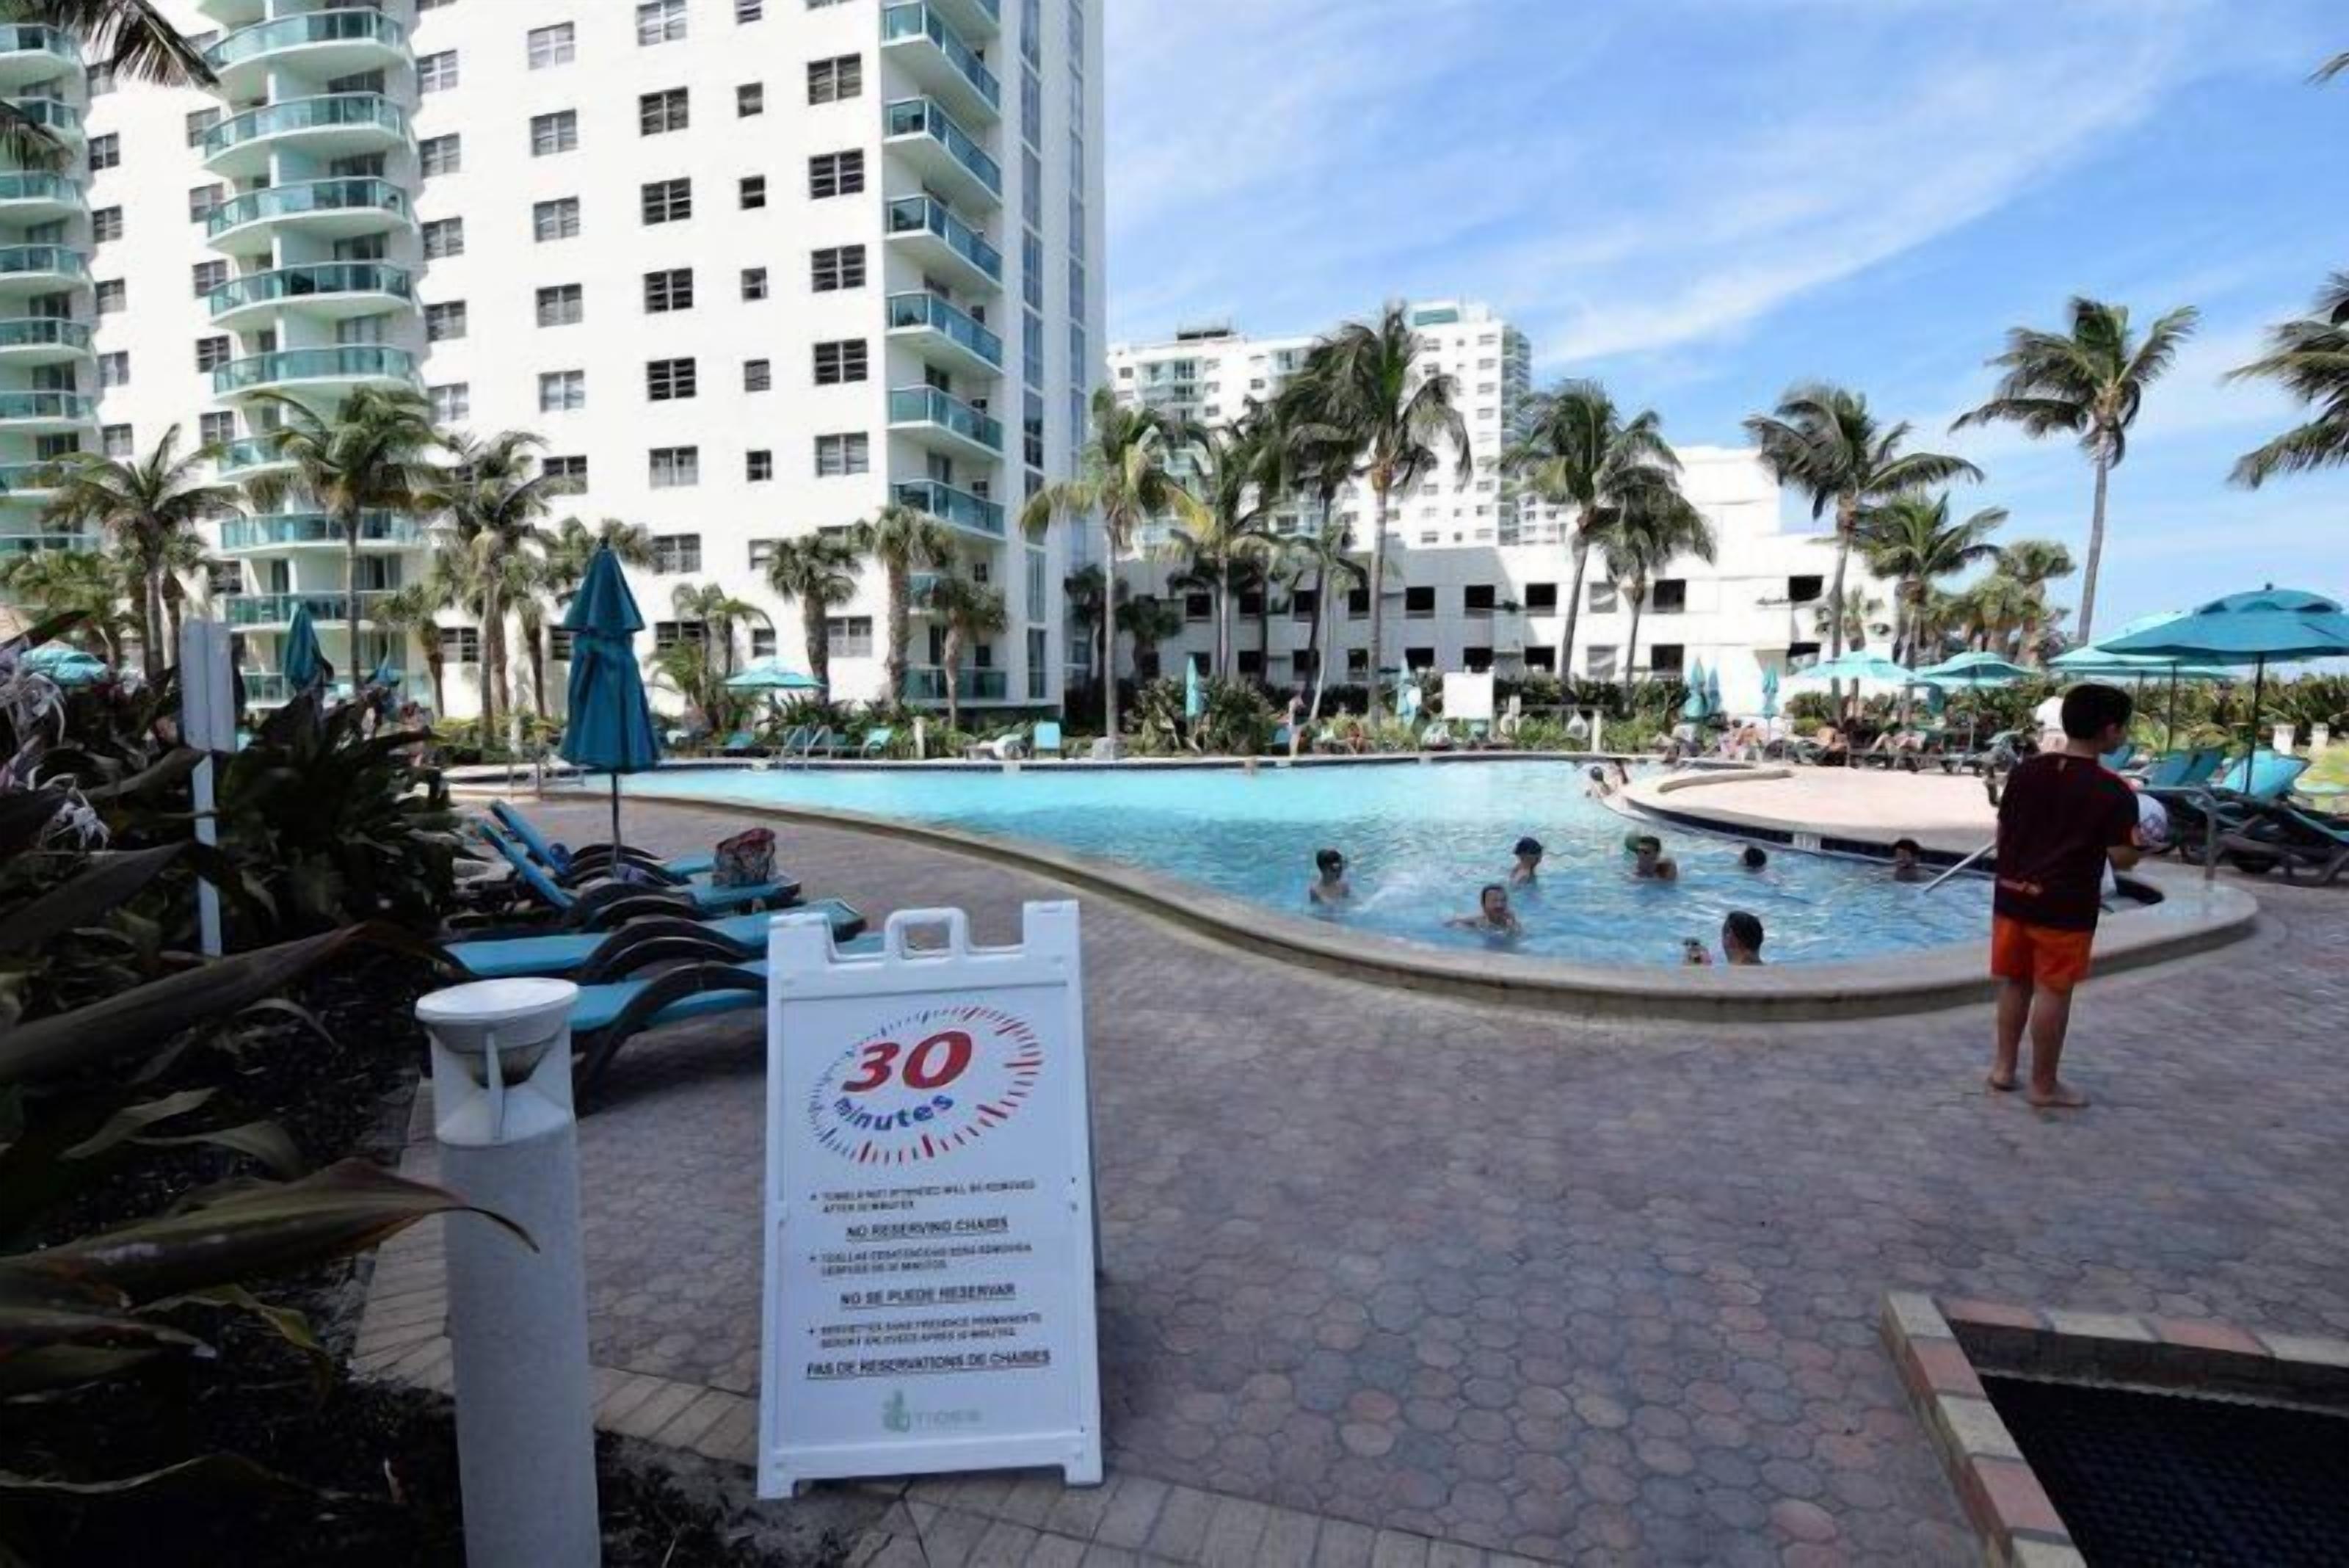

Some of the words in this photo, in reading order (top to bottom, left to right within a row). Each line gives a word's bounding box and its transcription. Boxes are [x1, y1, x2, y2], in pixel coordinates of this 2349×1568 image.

[843, 1031, 972, 1092] 30
[834, 1095, 954, 1130] minutes
[846, 1225, 868, 1238] NO
[871, 1220, 951, 1236] RESERVING
[841, 1291, 861, 1305] NO
[866, 1290, 883, 1303] SE
[887, 1288, 934, 1302] PUEDE
[939, 1283, 1015, 1300] RESERVAR
[807, 1361, 834, 1376] PAS
[837, 1360, 855, 1375] DE
[968, 1352, 986, 1366] DE
